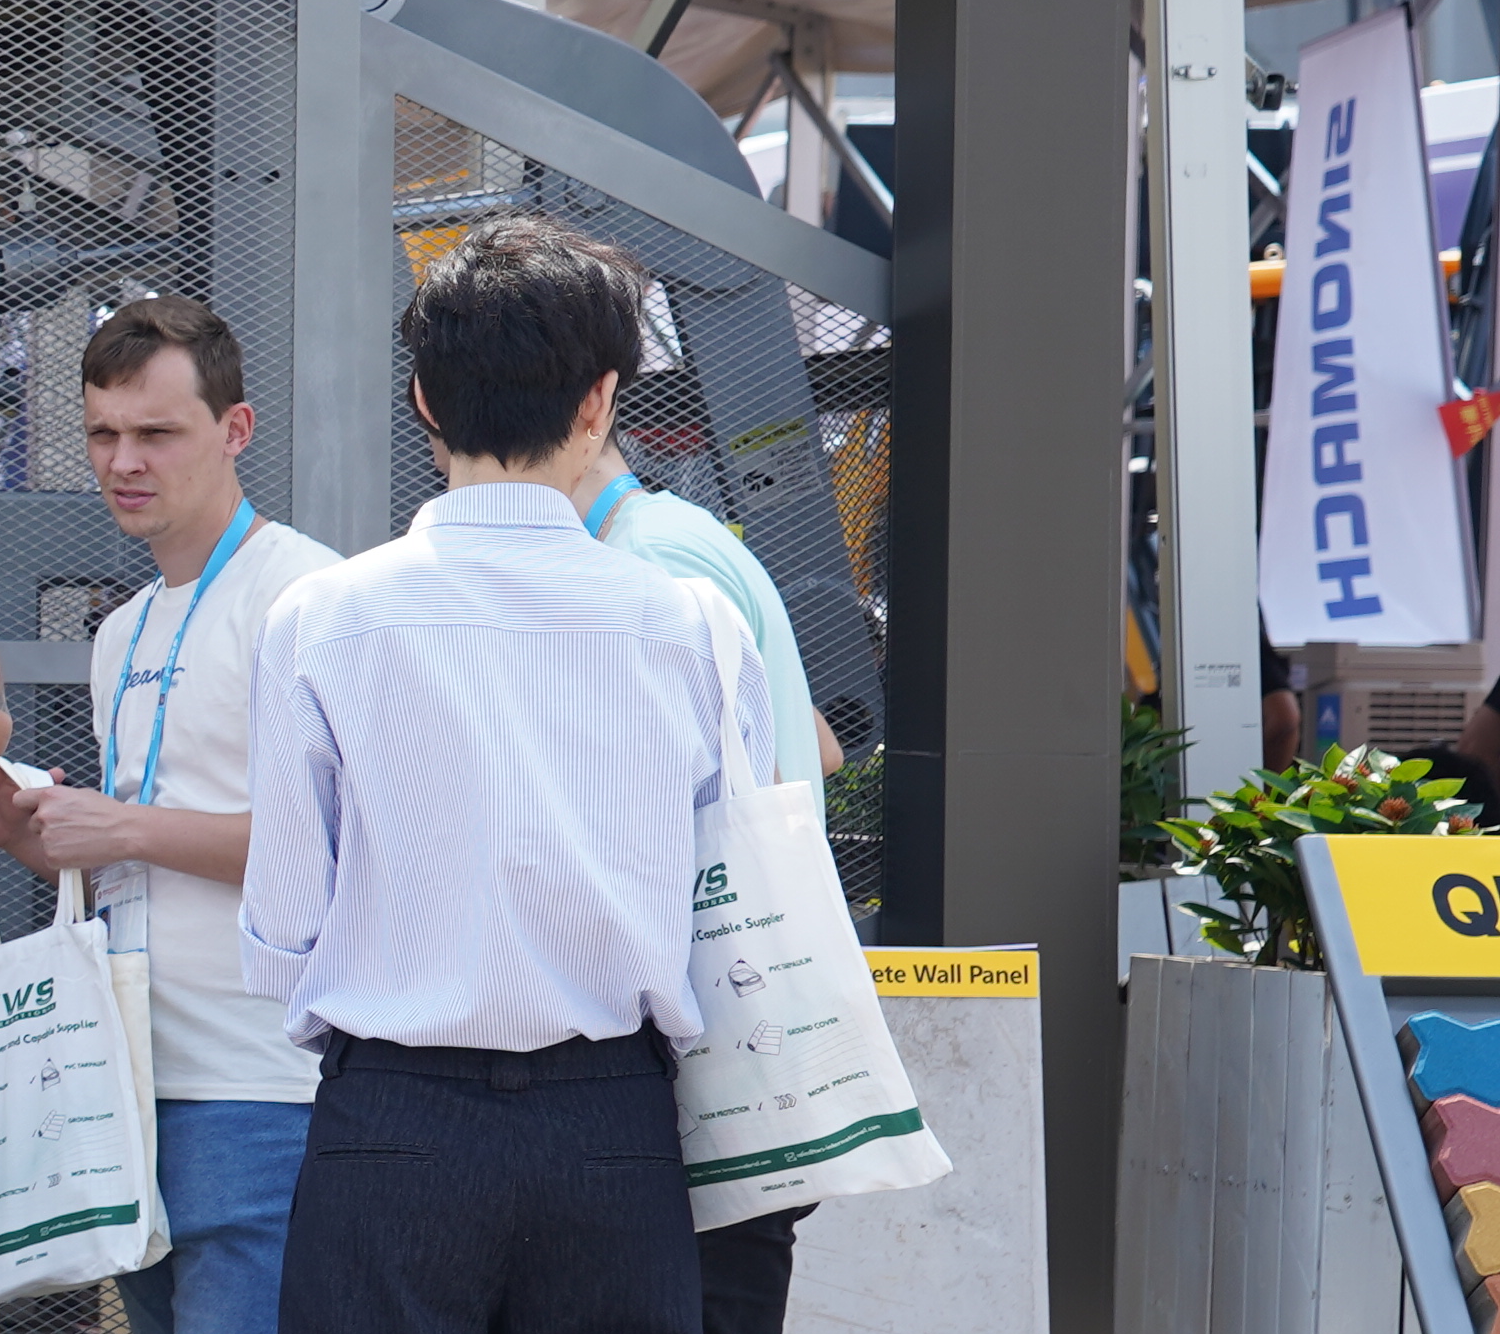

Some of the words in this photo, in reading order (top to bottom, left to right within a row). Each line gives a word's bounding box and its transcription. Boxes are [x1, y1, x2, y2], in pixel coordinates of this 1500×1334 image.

[696, 923, 742, 941] Capable
[744, 912, 785, 930] Supplier
[870, 965, 907, 984] ete
[913, 963, 962, 984] Wall
[969, 964, 1029, 985] Panel
[56, 1019, 99, 1034] Supplier
[786, 1023, 814, 1037] GROUND
[814, 1016, 840, 1030] COVER
